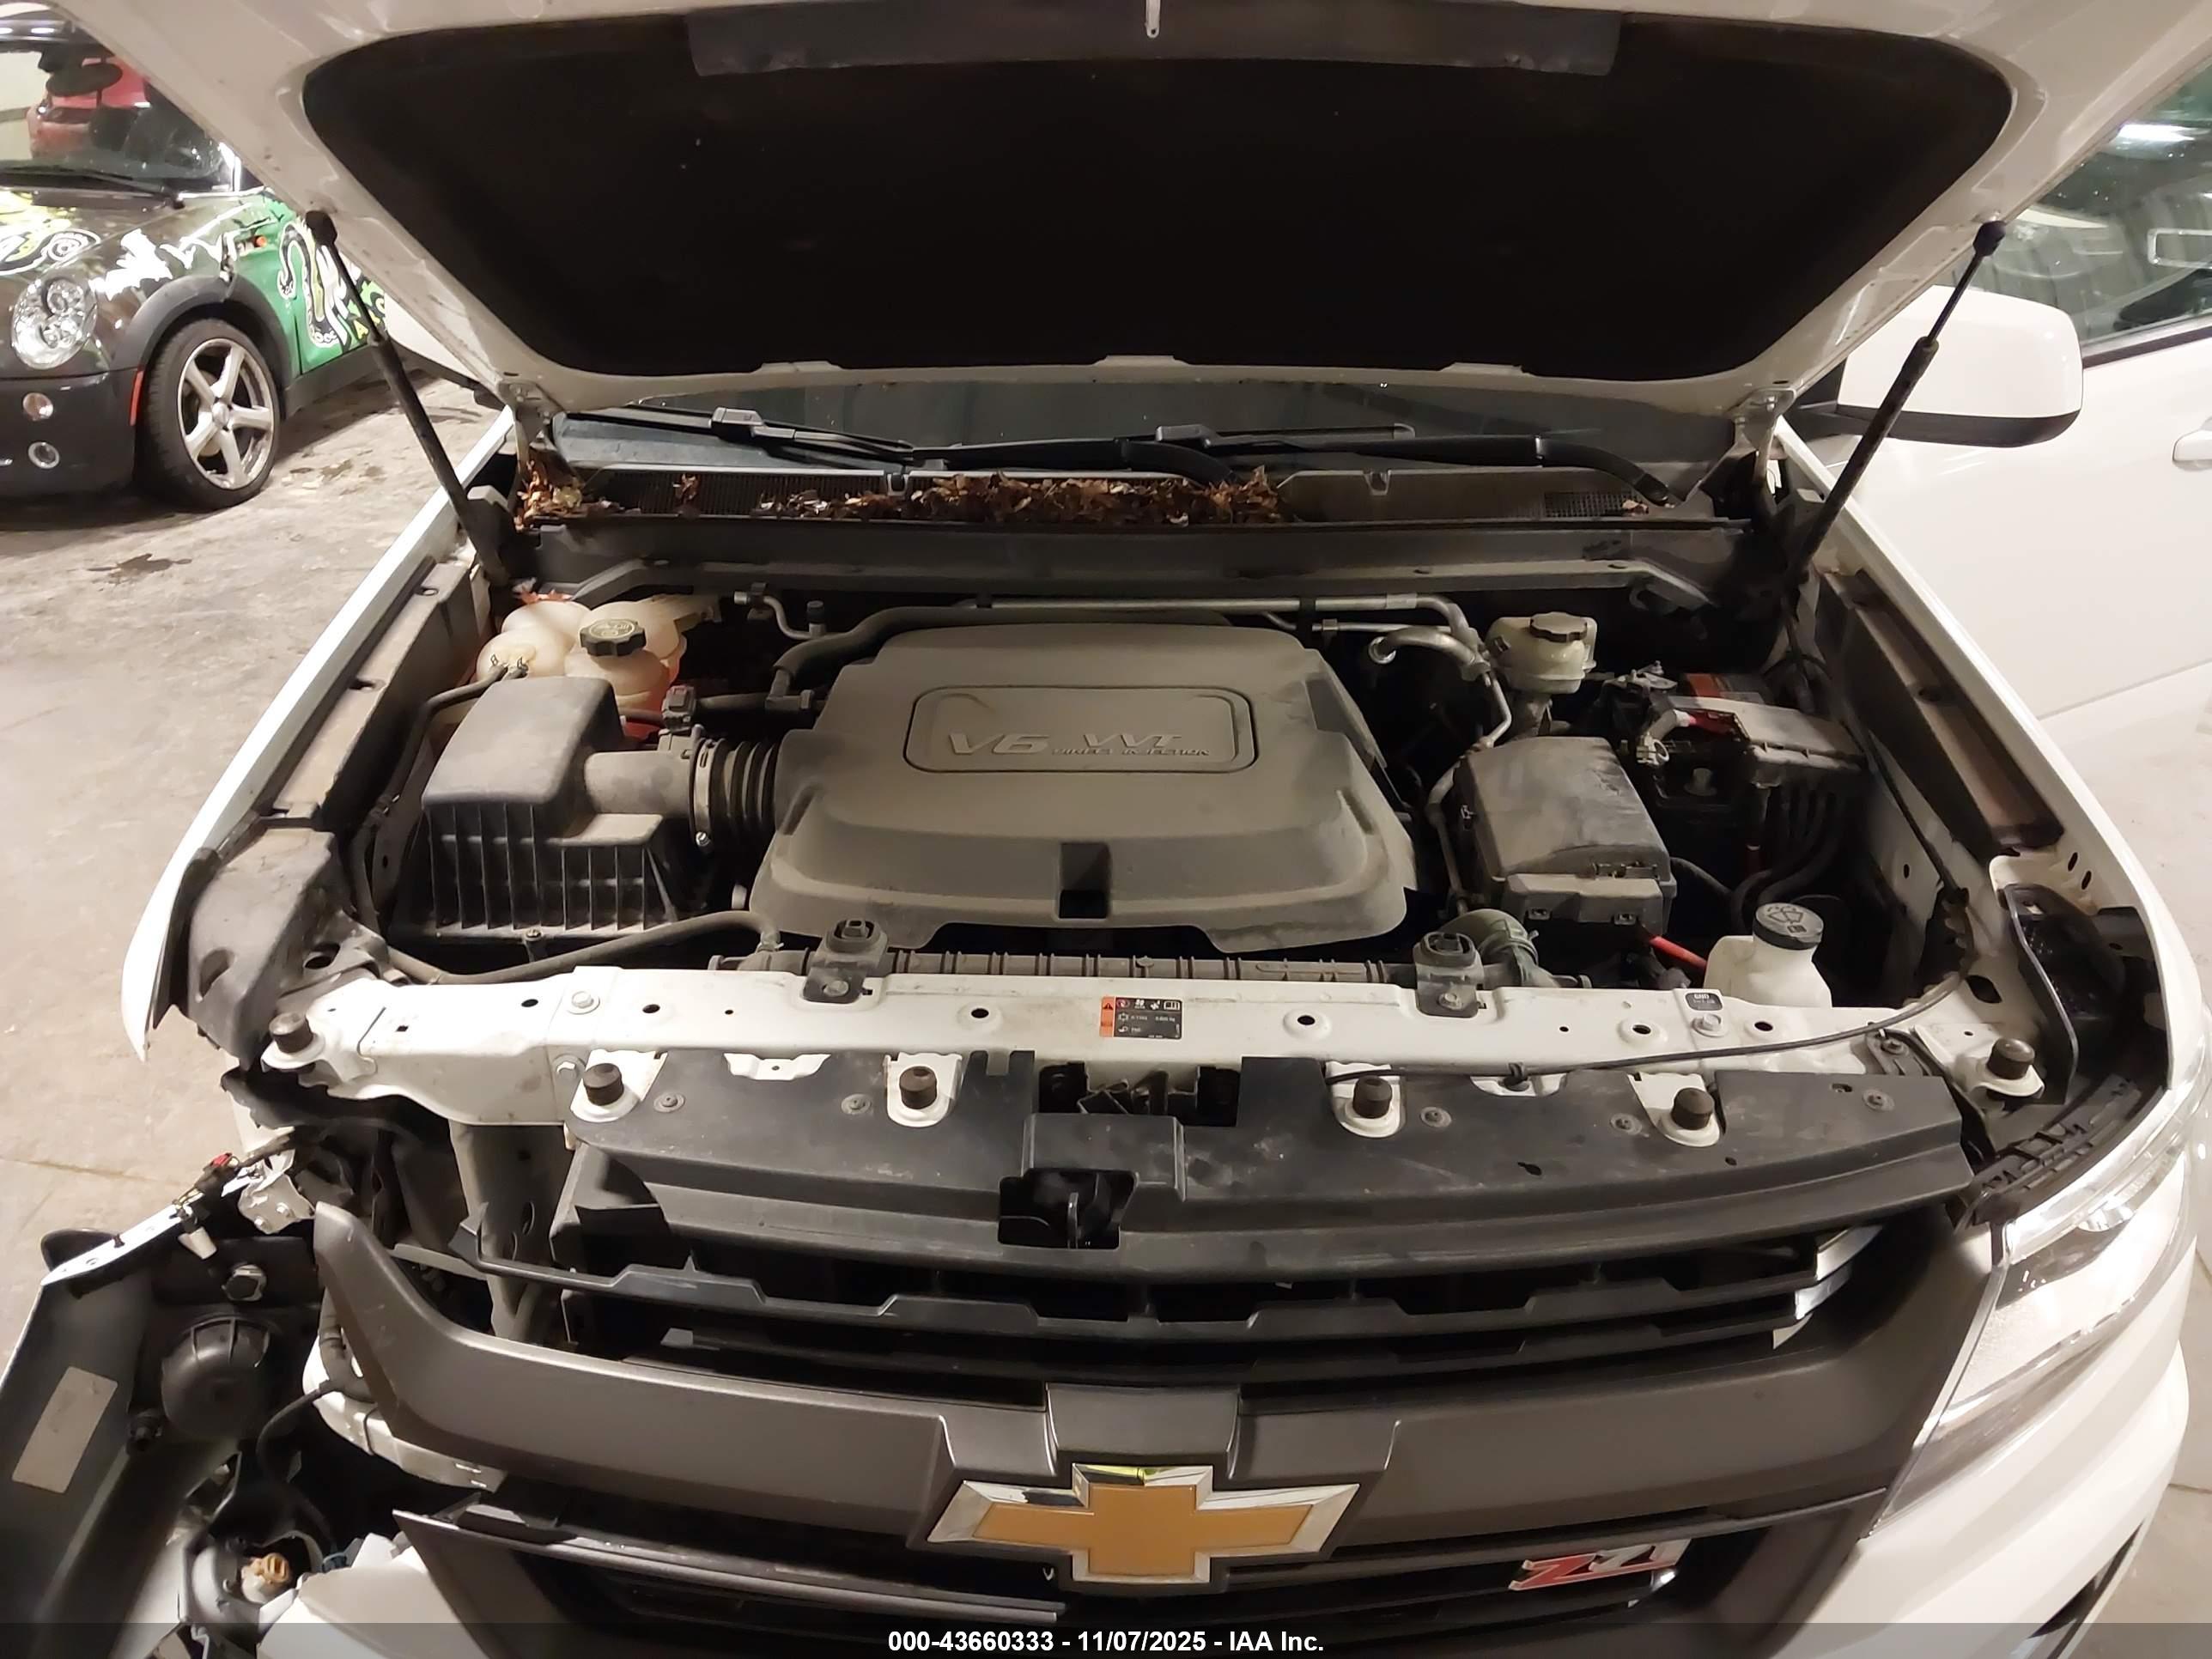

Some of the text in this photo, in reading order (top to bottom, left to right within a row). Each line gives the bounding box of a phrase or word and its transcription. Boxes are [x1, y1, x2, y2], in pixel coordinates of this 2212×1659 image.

[949, 733, 1049, 755] V6
[1083, 733, 1182, 747] VVT
[1509, 1538, 1691, 1591] Z71
